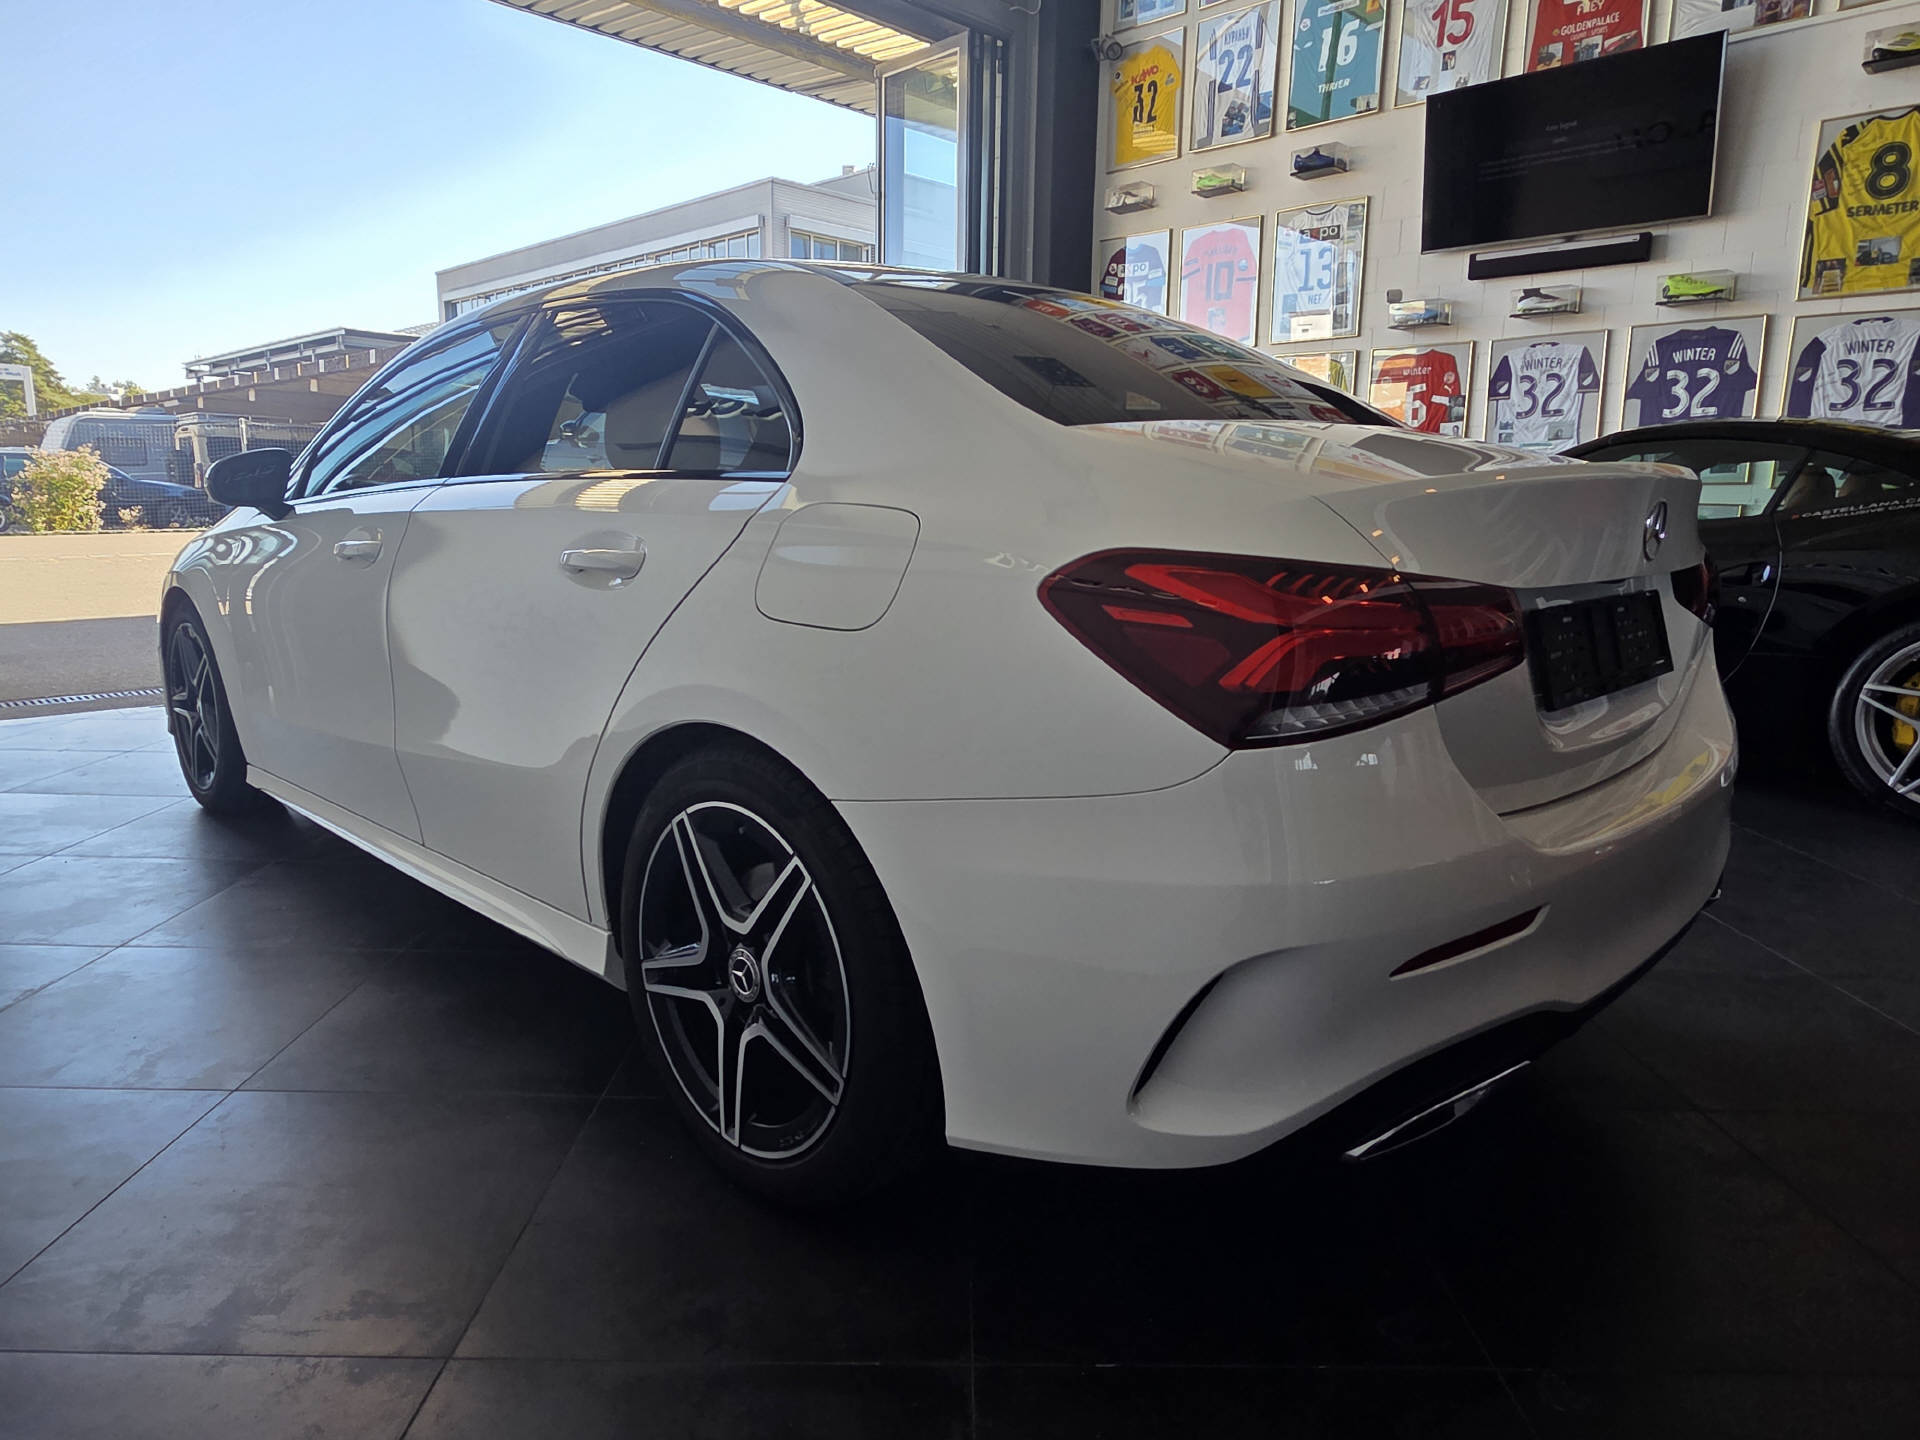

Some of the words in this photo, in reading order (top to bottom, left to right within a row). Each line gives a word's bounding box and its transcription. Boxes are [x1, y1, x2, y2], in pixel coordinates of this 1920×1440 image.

[1431, 0, 1475, 48] 15
[1560, 11, 1621, 36] GOLDENPALACE
[1318, 19, 1360, 72] 16
[1218, 44, 1253, 93] 22
[1132, 79, 1158, 123] 32
[1865, 141, 1912, 200] 8
[1847, 200, 1919, 218] SERMETER
[1206, 260, 1234, 301] 10
[1298, 247, 1333, 292] 13
[1308, 293, 1322, 305] NEF
[1523, 356, 1563, 371] WINTER
[1672, 347, 1716, 364] WINTER
[1845, 339, 1896, 355] WINTER
[1402, 366, 1432, 376] winter
[1829, 358, 1899, 412] 32
[1515, 372, 1565, 420] 32
[1662, 367, 1720, 418] 32
[1801, 498, 1920, 518] CASTELLANA.C
